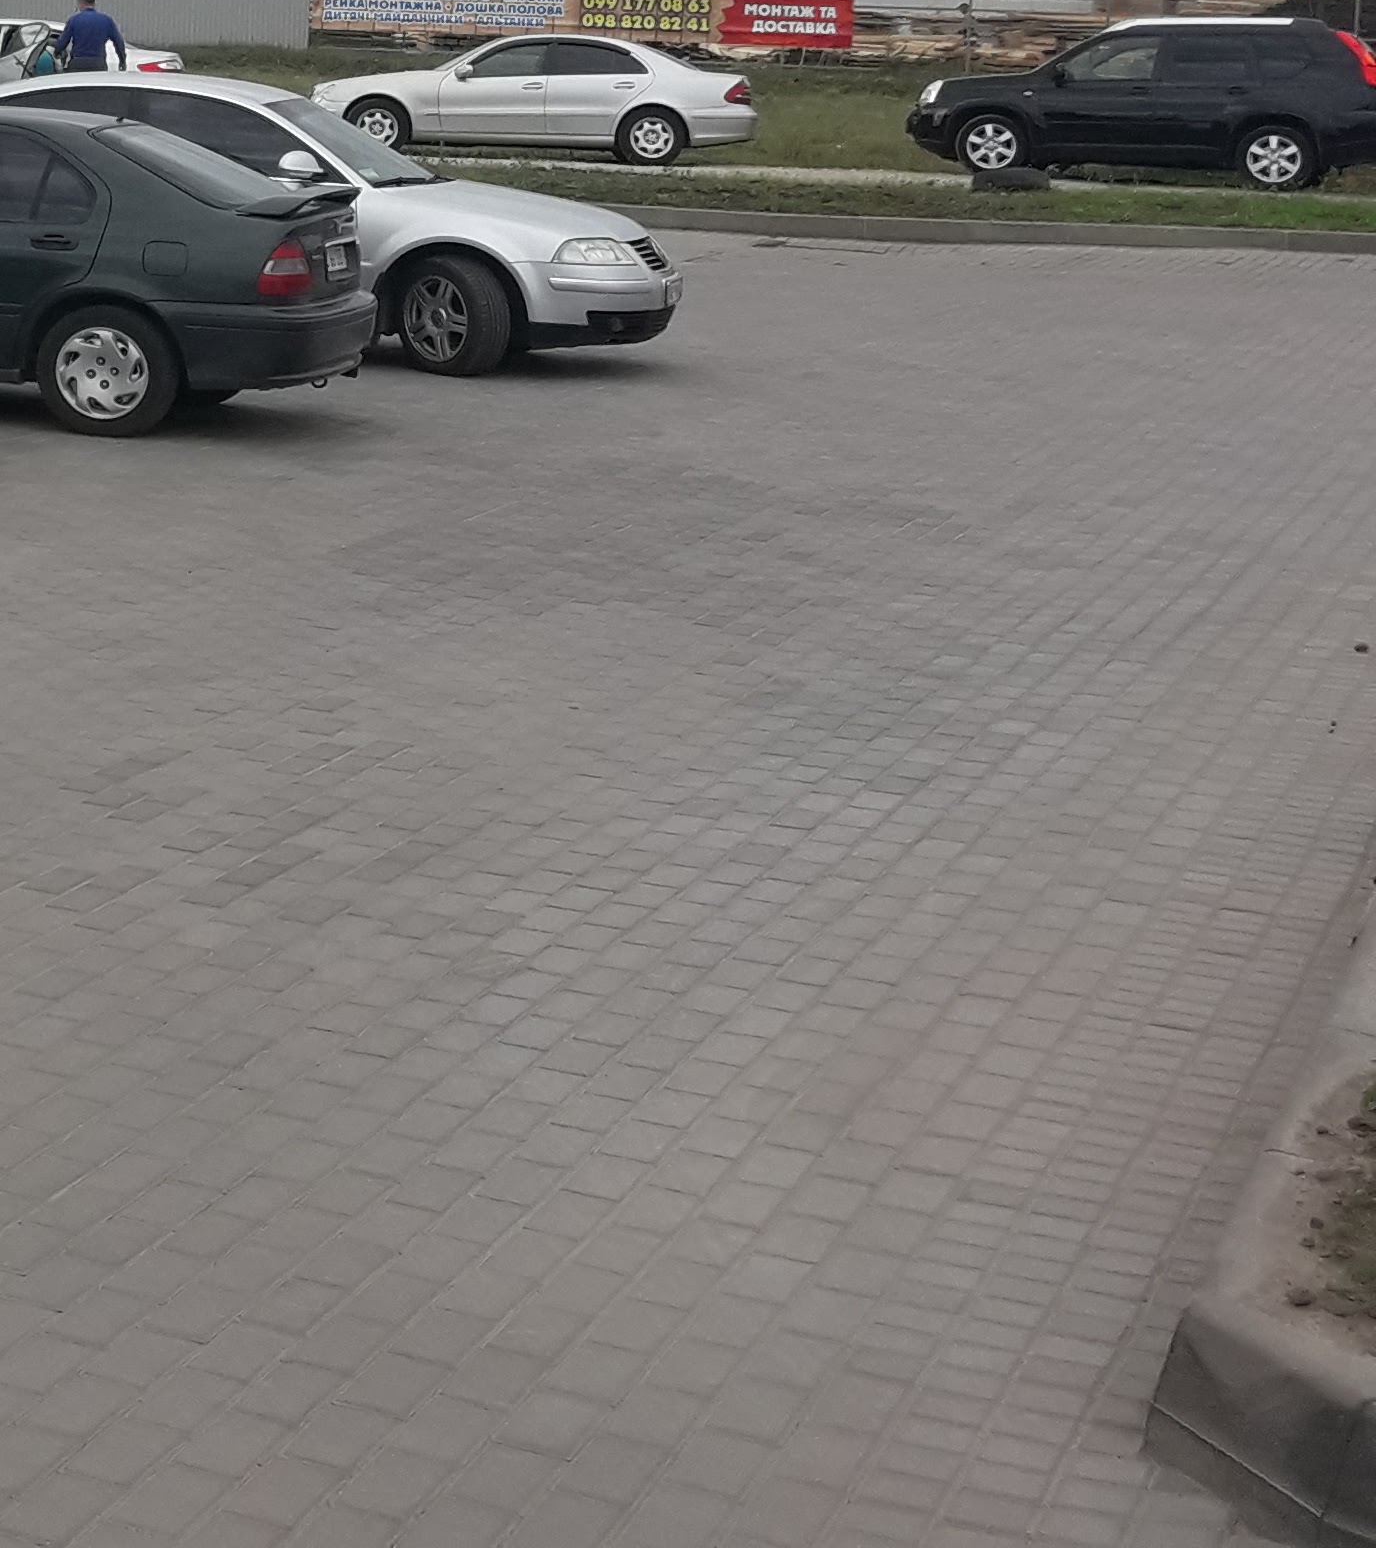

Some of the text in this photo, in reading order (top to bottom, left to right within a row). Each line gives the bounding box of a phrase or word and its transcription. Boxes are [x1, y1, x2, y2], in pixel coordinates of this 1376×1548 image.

[369, 0, 442, 11] МОНТАЖНА
[455, 3, 505, 15] ДОШКА
[508, 4, 563, 16] ПОЛОВА
[687, 0, 710, 13] 63
[744, 4, 837, 19] МОНТАЖ ТА
[582, 14, 710, 32] 098 820 82 41
[752, 20, 837, 35] ДОСТАВКА
